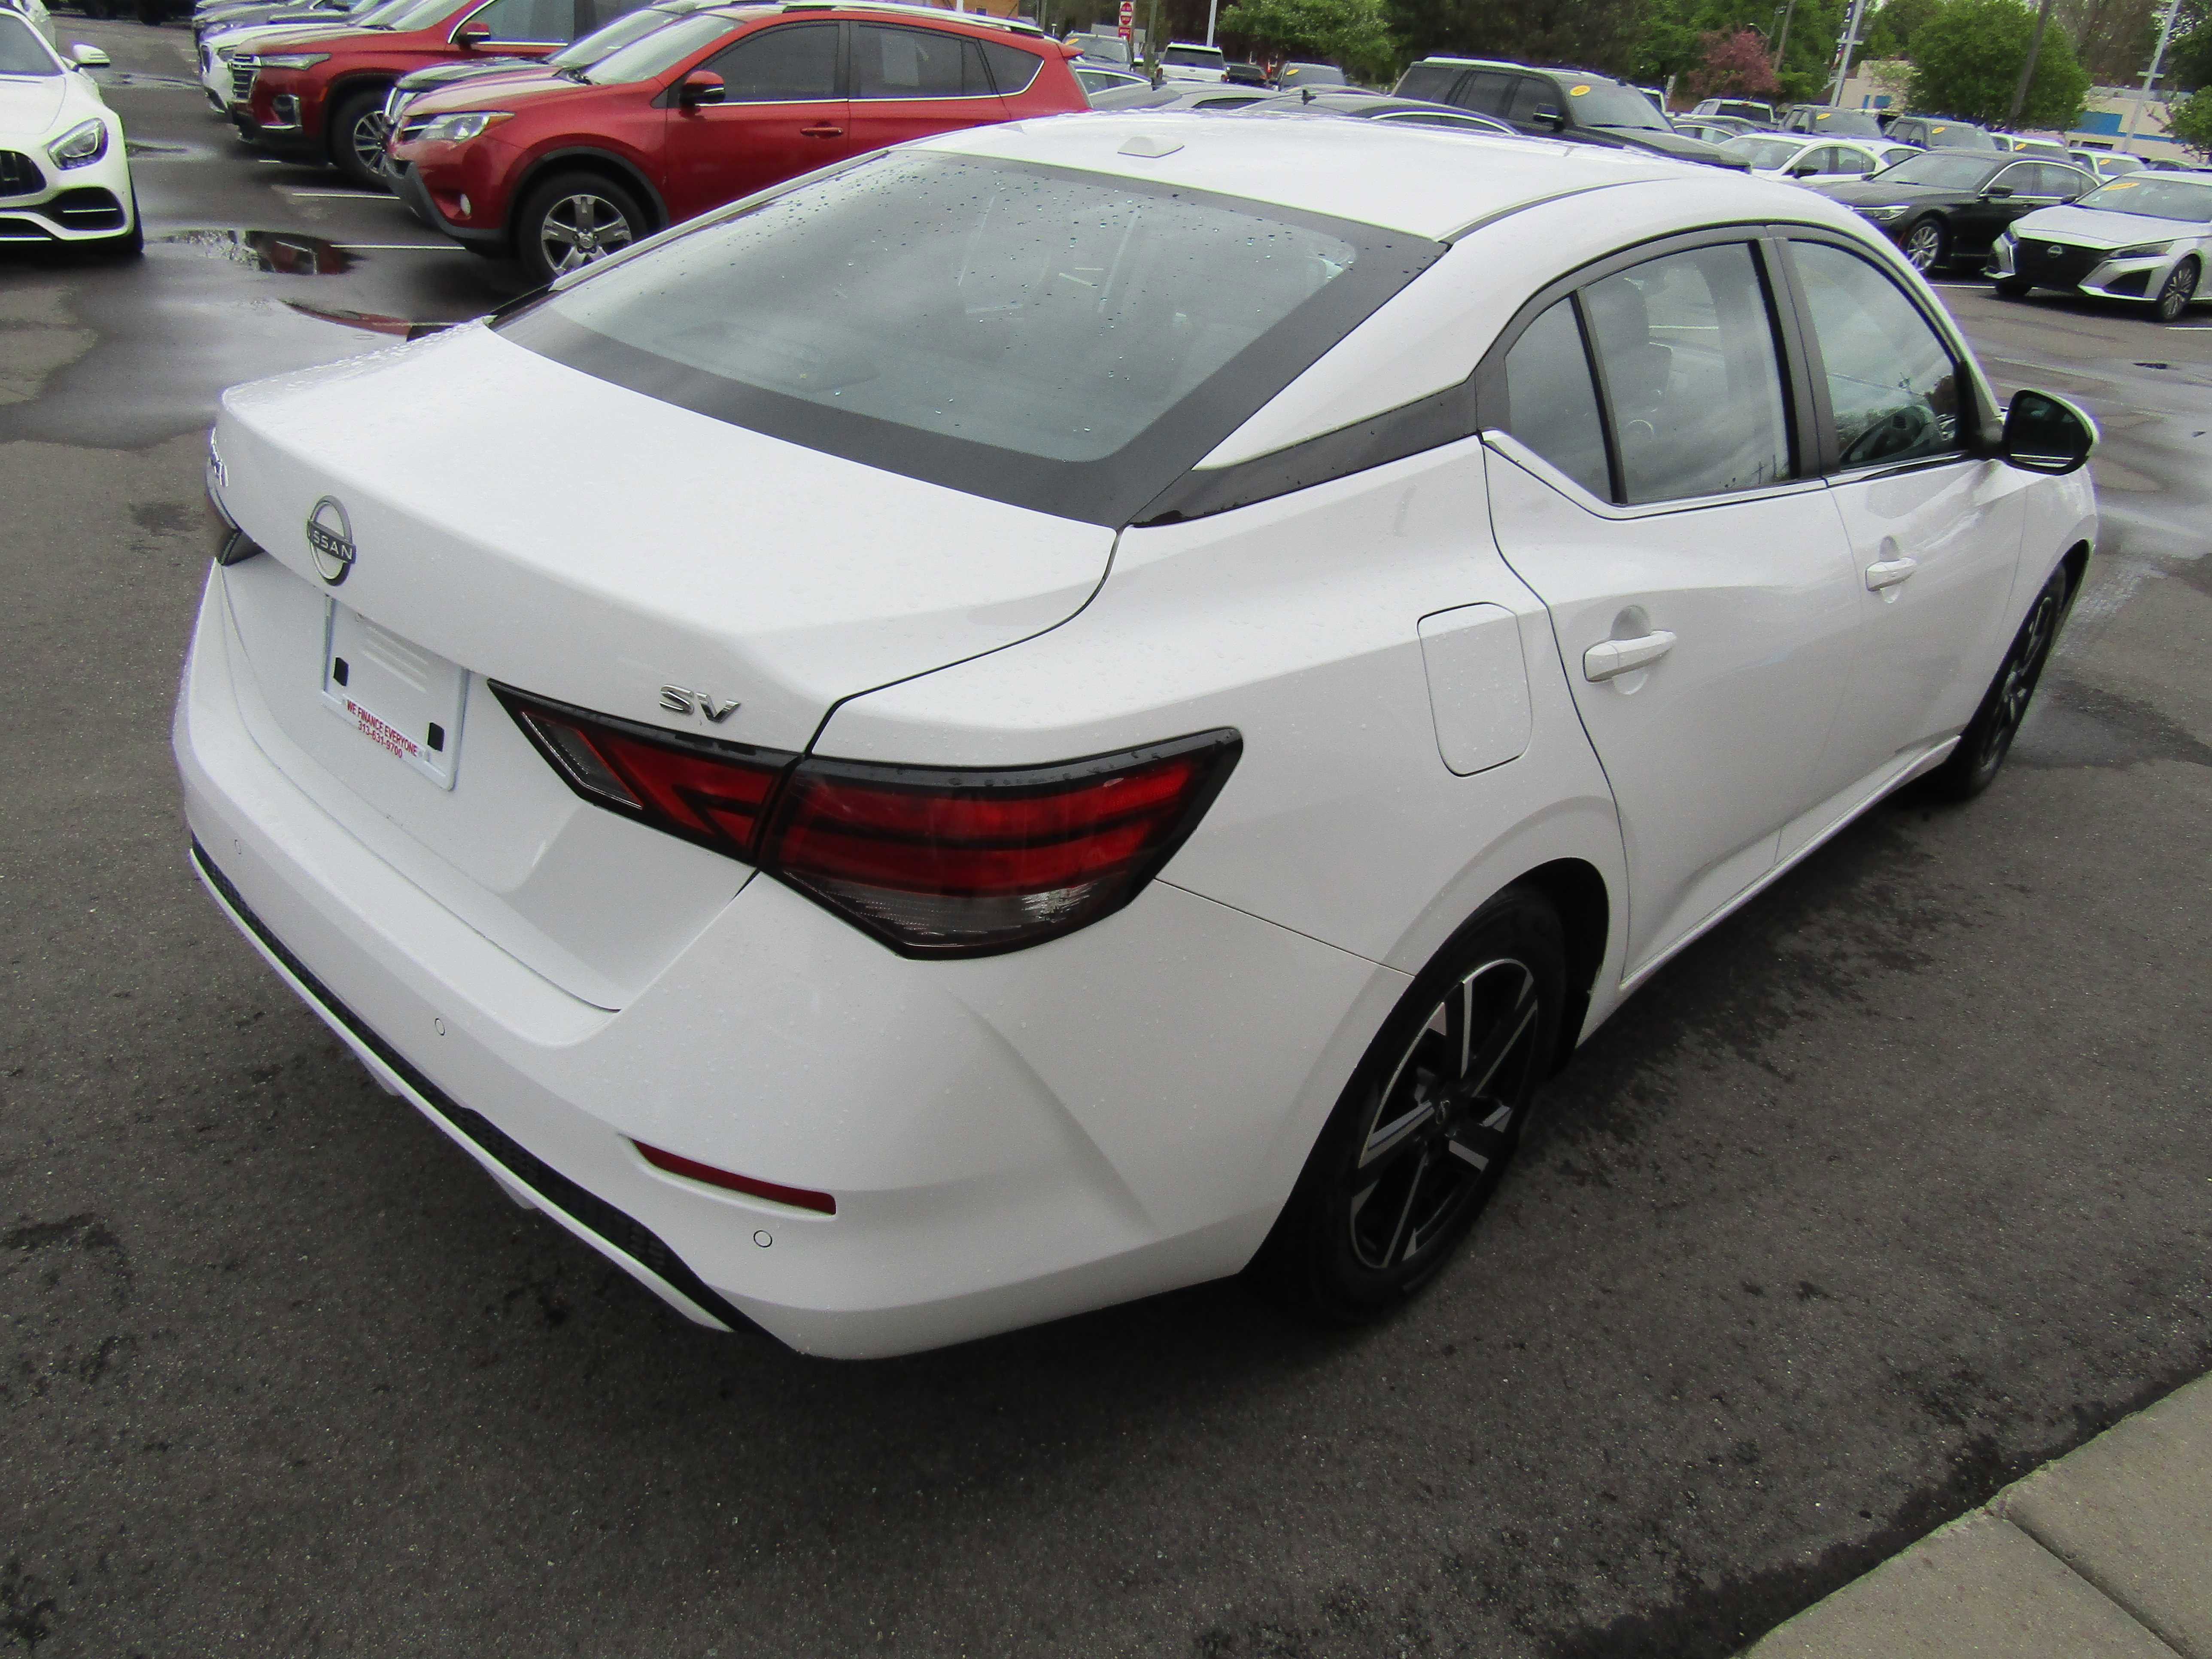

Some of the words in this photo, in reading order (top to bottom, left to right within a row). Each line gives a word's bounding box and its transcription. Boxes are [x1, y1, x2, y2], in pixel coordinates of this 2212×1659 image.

[659, 684, 741, 723] SV
[347, 699, 357, 715] WE
[358, 706, 383, 733] FINANCE
[384, 725, 418, 757] EVERYONE
[358, 720, 403, 758] 313-631-9700
